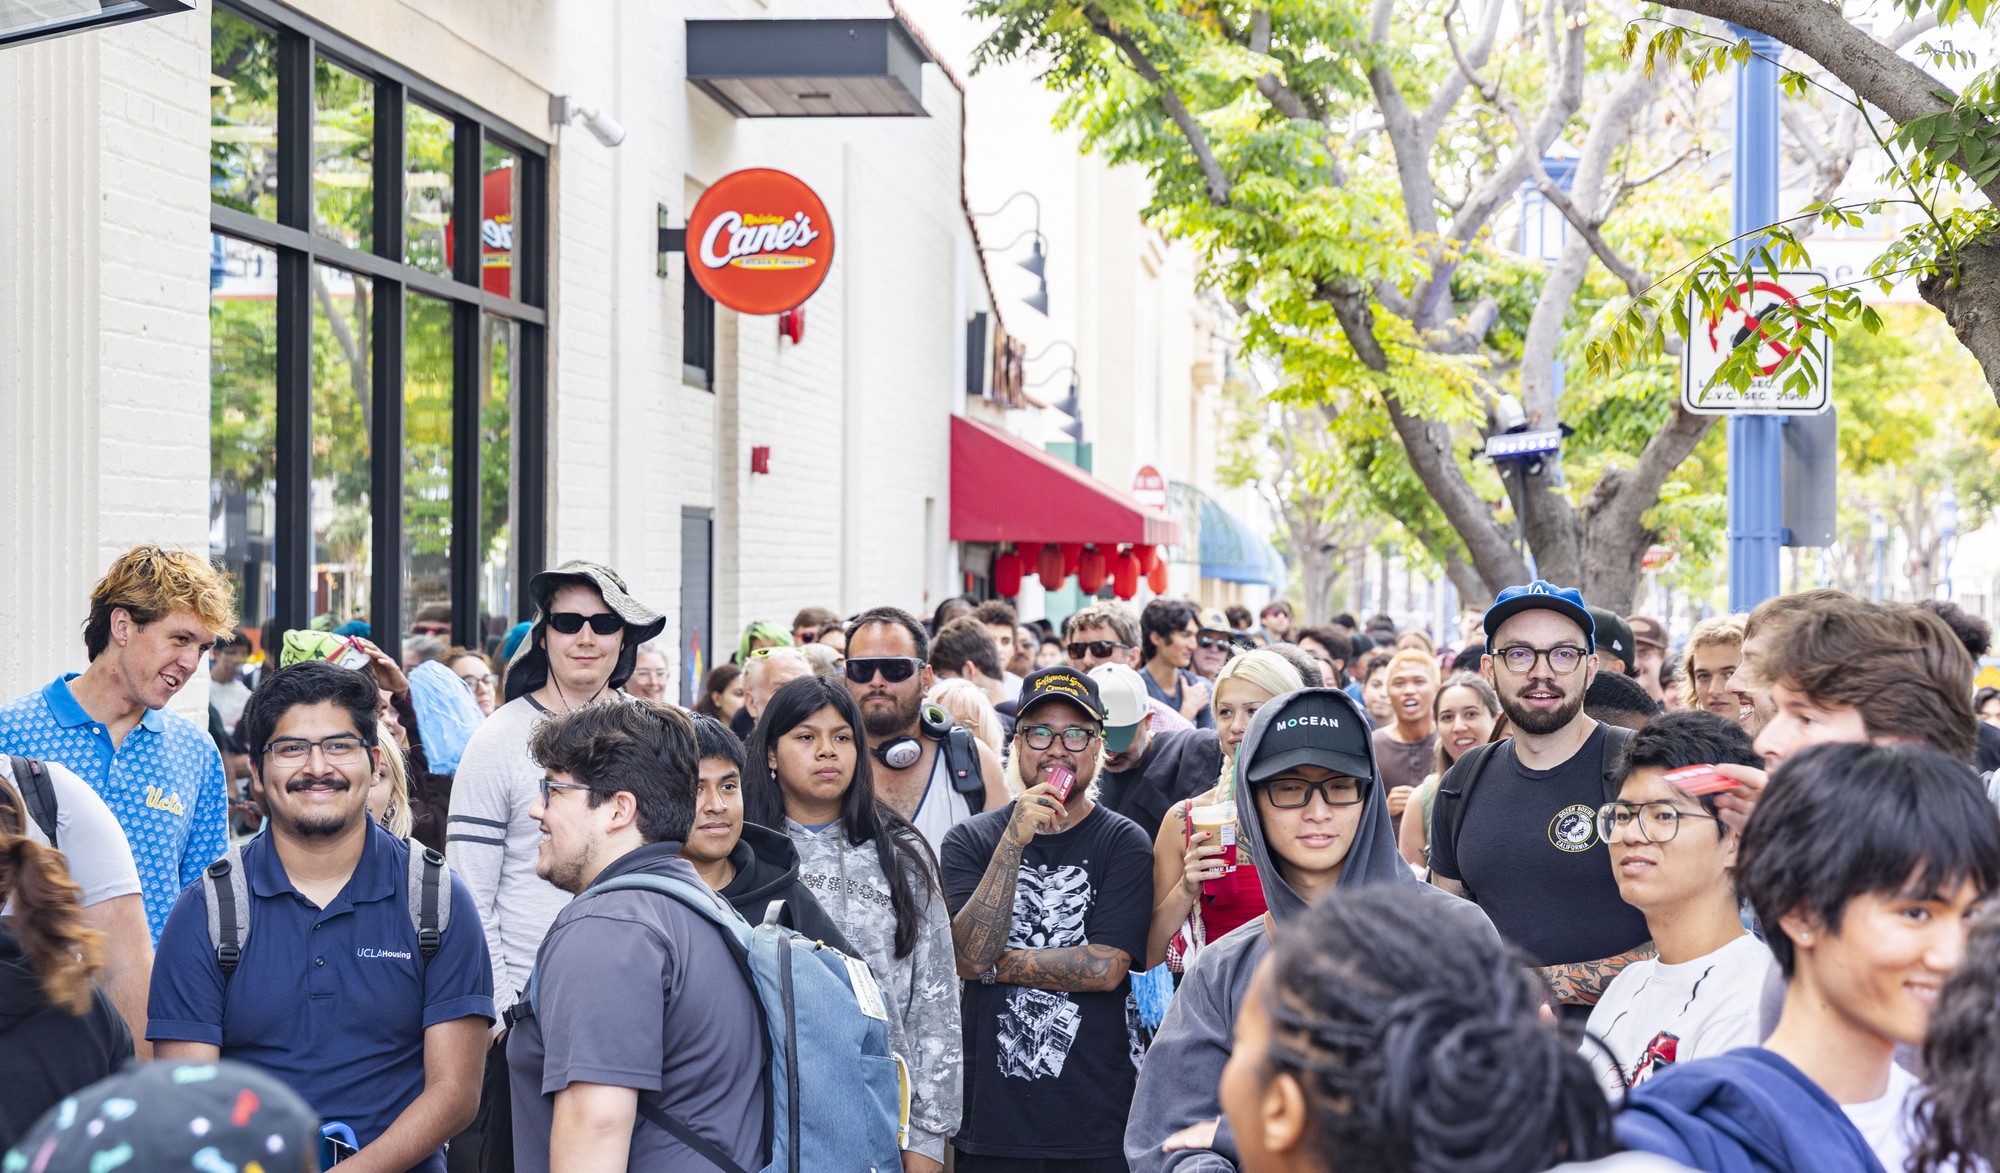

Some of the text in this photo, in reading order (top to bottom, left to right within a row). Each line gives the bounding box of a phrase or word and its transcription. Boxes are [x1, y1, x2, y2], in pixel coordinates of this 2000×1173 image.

[743, 213, 784, 226] Raising
[700, 210, 819, 269] Cane's
[1276, 716, 1339, 731] MOCEAN
[146, 785, 184, 817] Ucla
[1555, 840, 1590, 851] CALIFORNIA
[801, 873, 895, 913] WSTON
